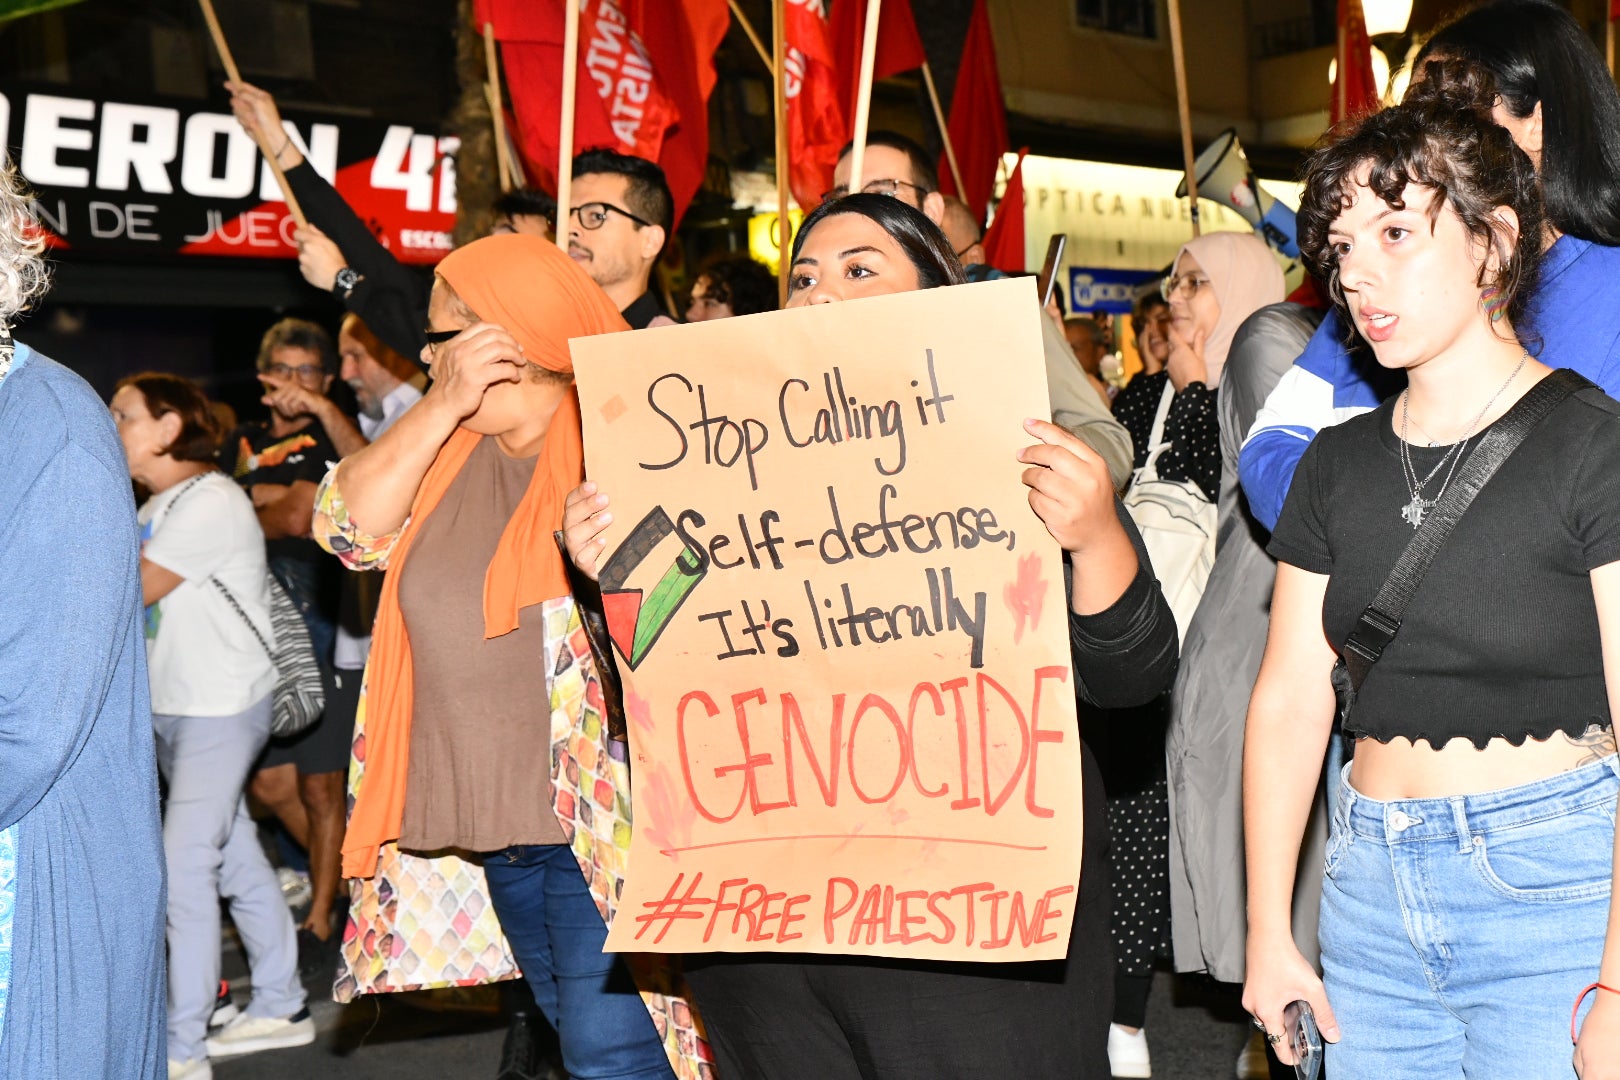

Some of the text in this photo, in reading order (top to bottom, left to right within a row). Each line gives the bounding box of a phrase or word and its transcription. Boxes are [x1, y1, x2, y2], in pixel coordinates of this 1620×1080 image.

[0, 92, 339, 201] ERON
[89, 201, 161, 241] DE
[1024, 187, 1125, 217] PTICA
[639, 349, 954, 490] Stop Calling it
[675, 484, 1016, 576] Self-defense,
[698, 566, 987, 668] It's literally
[677, 665, 1070, 824] GENOCIDE
[635, 872, 1075, 949] #FREE PALESTINE
